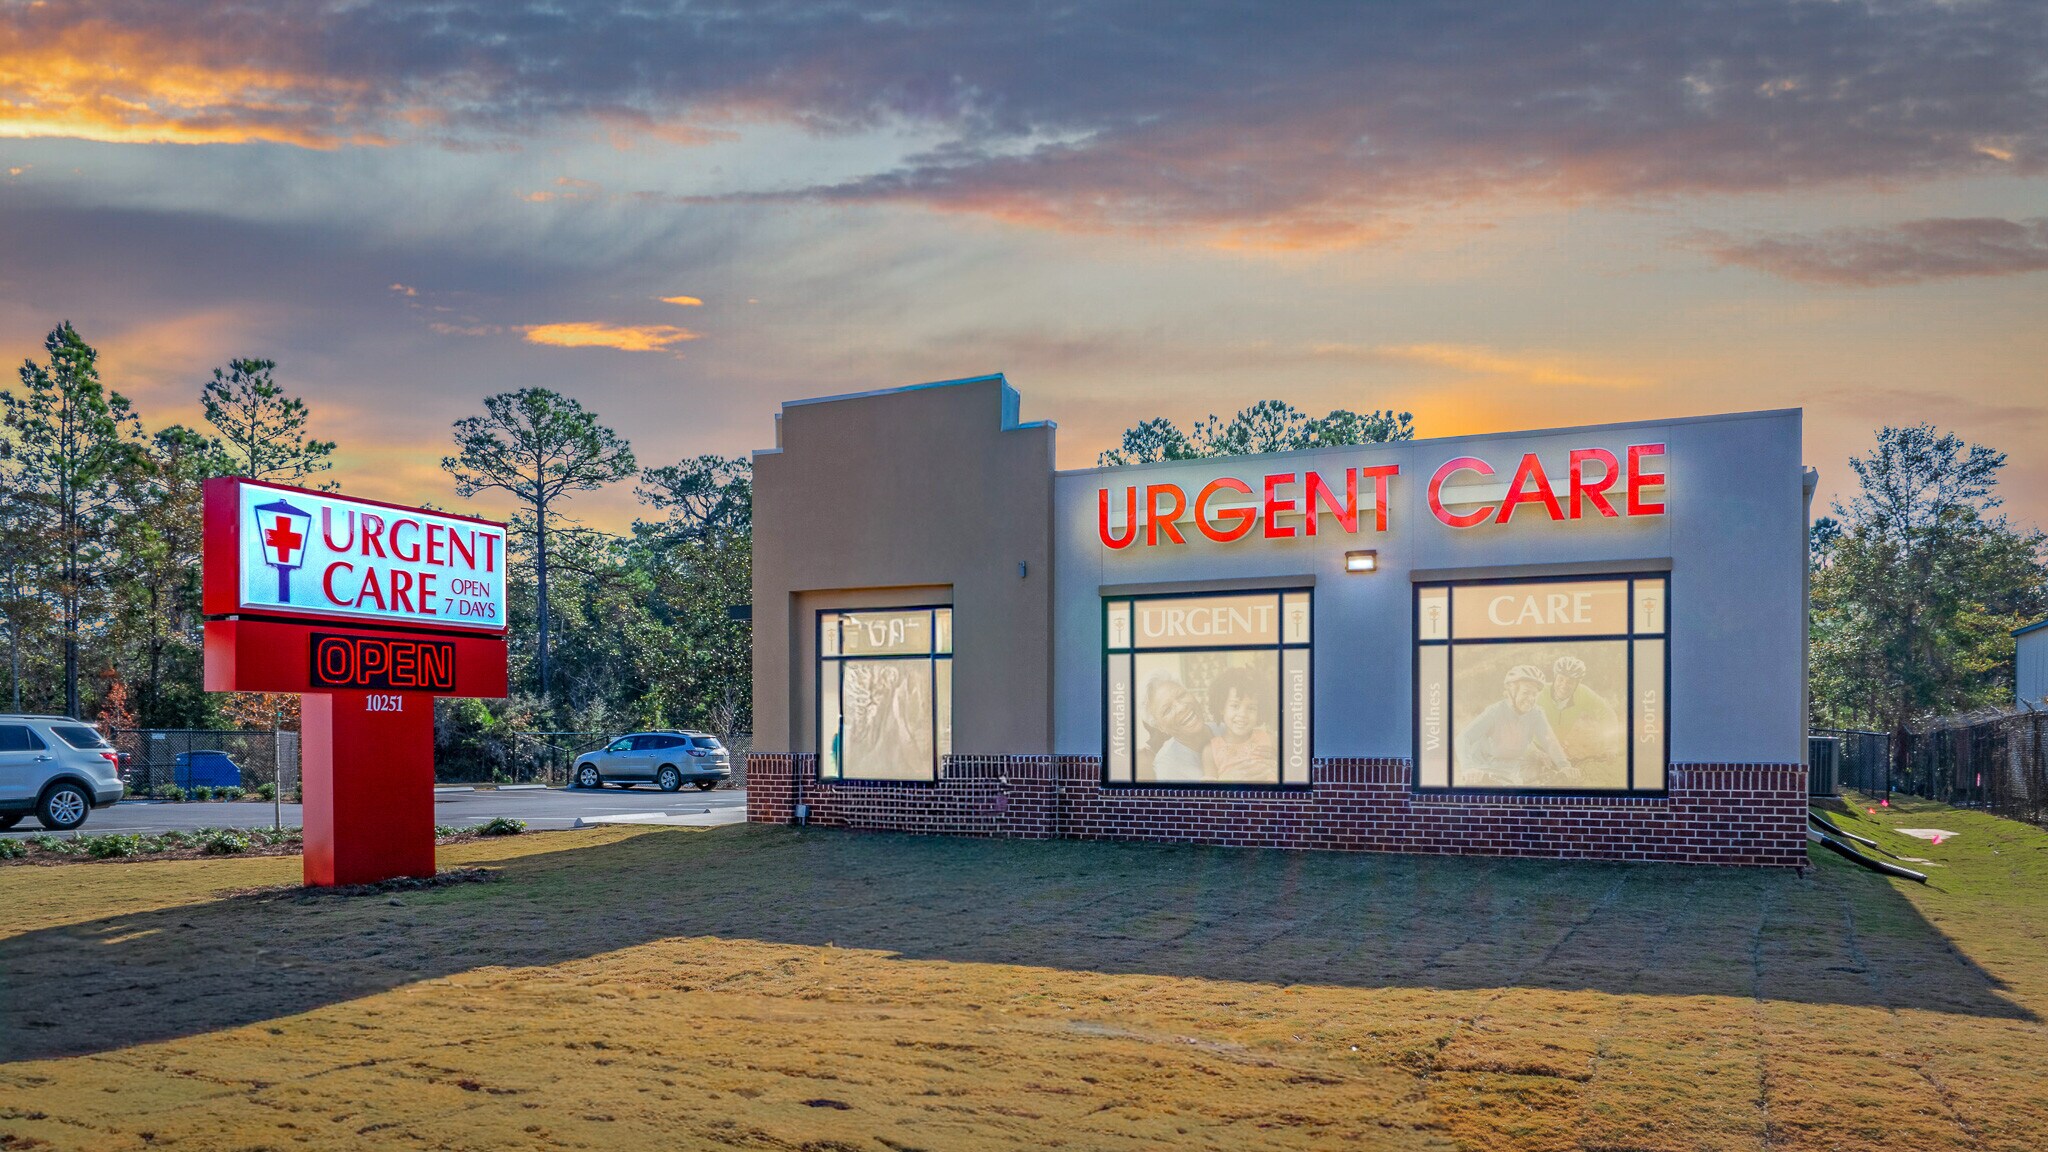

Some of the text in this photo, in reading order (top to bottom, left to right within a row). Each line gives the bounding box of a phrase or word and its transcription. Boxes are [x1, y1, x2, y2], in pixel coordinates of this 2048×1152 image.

[1097, 443, 1666, 549] URGENT CARE
[321, 506, 501, 572] URGENT
[322, 561, 437, 615] CARE
[444, 597, 496, 618] 7 DAYS
[451, 578, 490, 598] OPEN
[1487, 592, 1592, 626] CARE
[1142, 605, 1274, 637] URGENT
[317, 637, 453, 687] OPEN
[365, 694, 404, 712] 10251
[1112, 681, 1126, 758] Affordable
[1289, 669, 1306, 768] Occupational
[1426, 682, 1441, 751] Wellness
[1640, 689, 1658, 744] Sports
